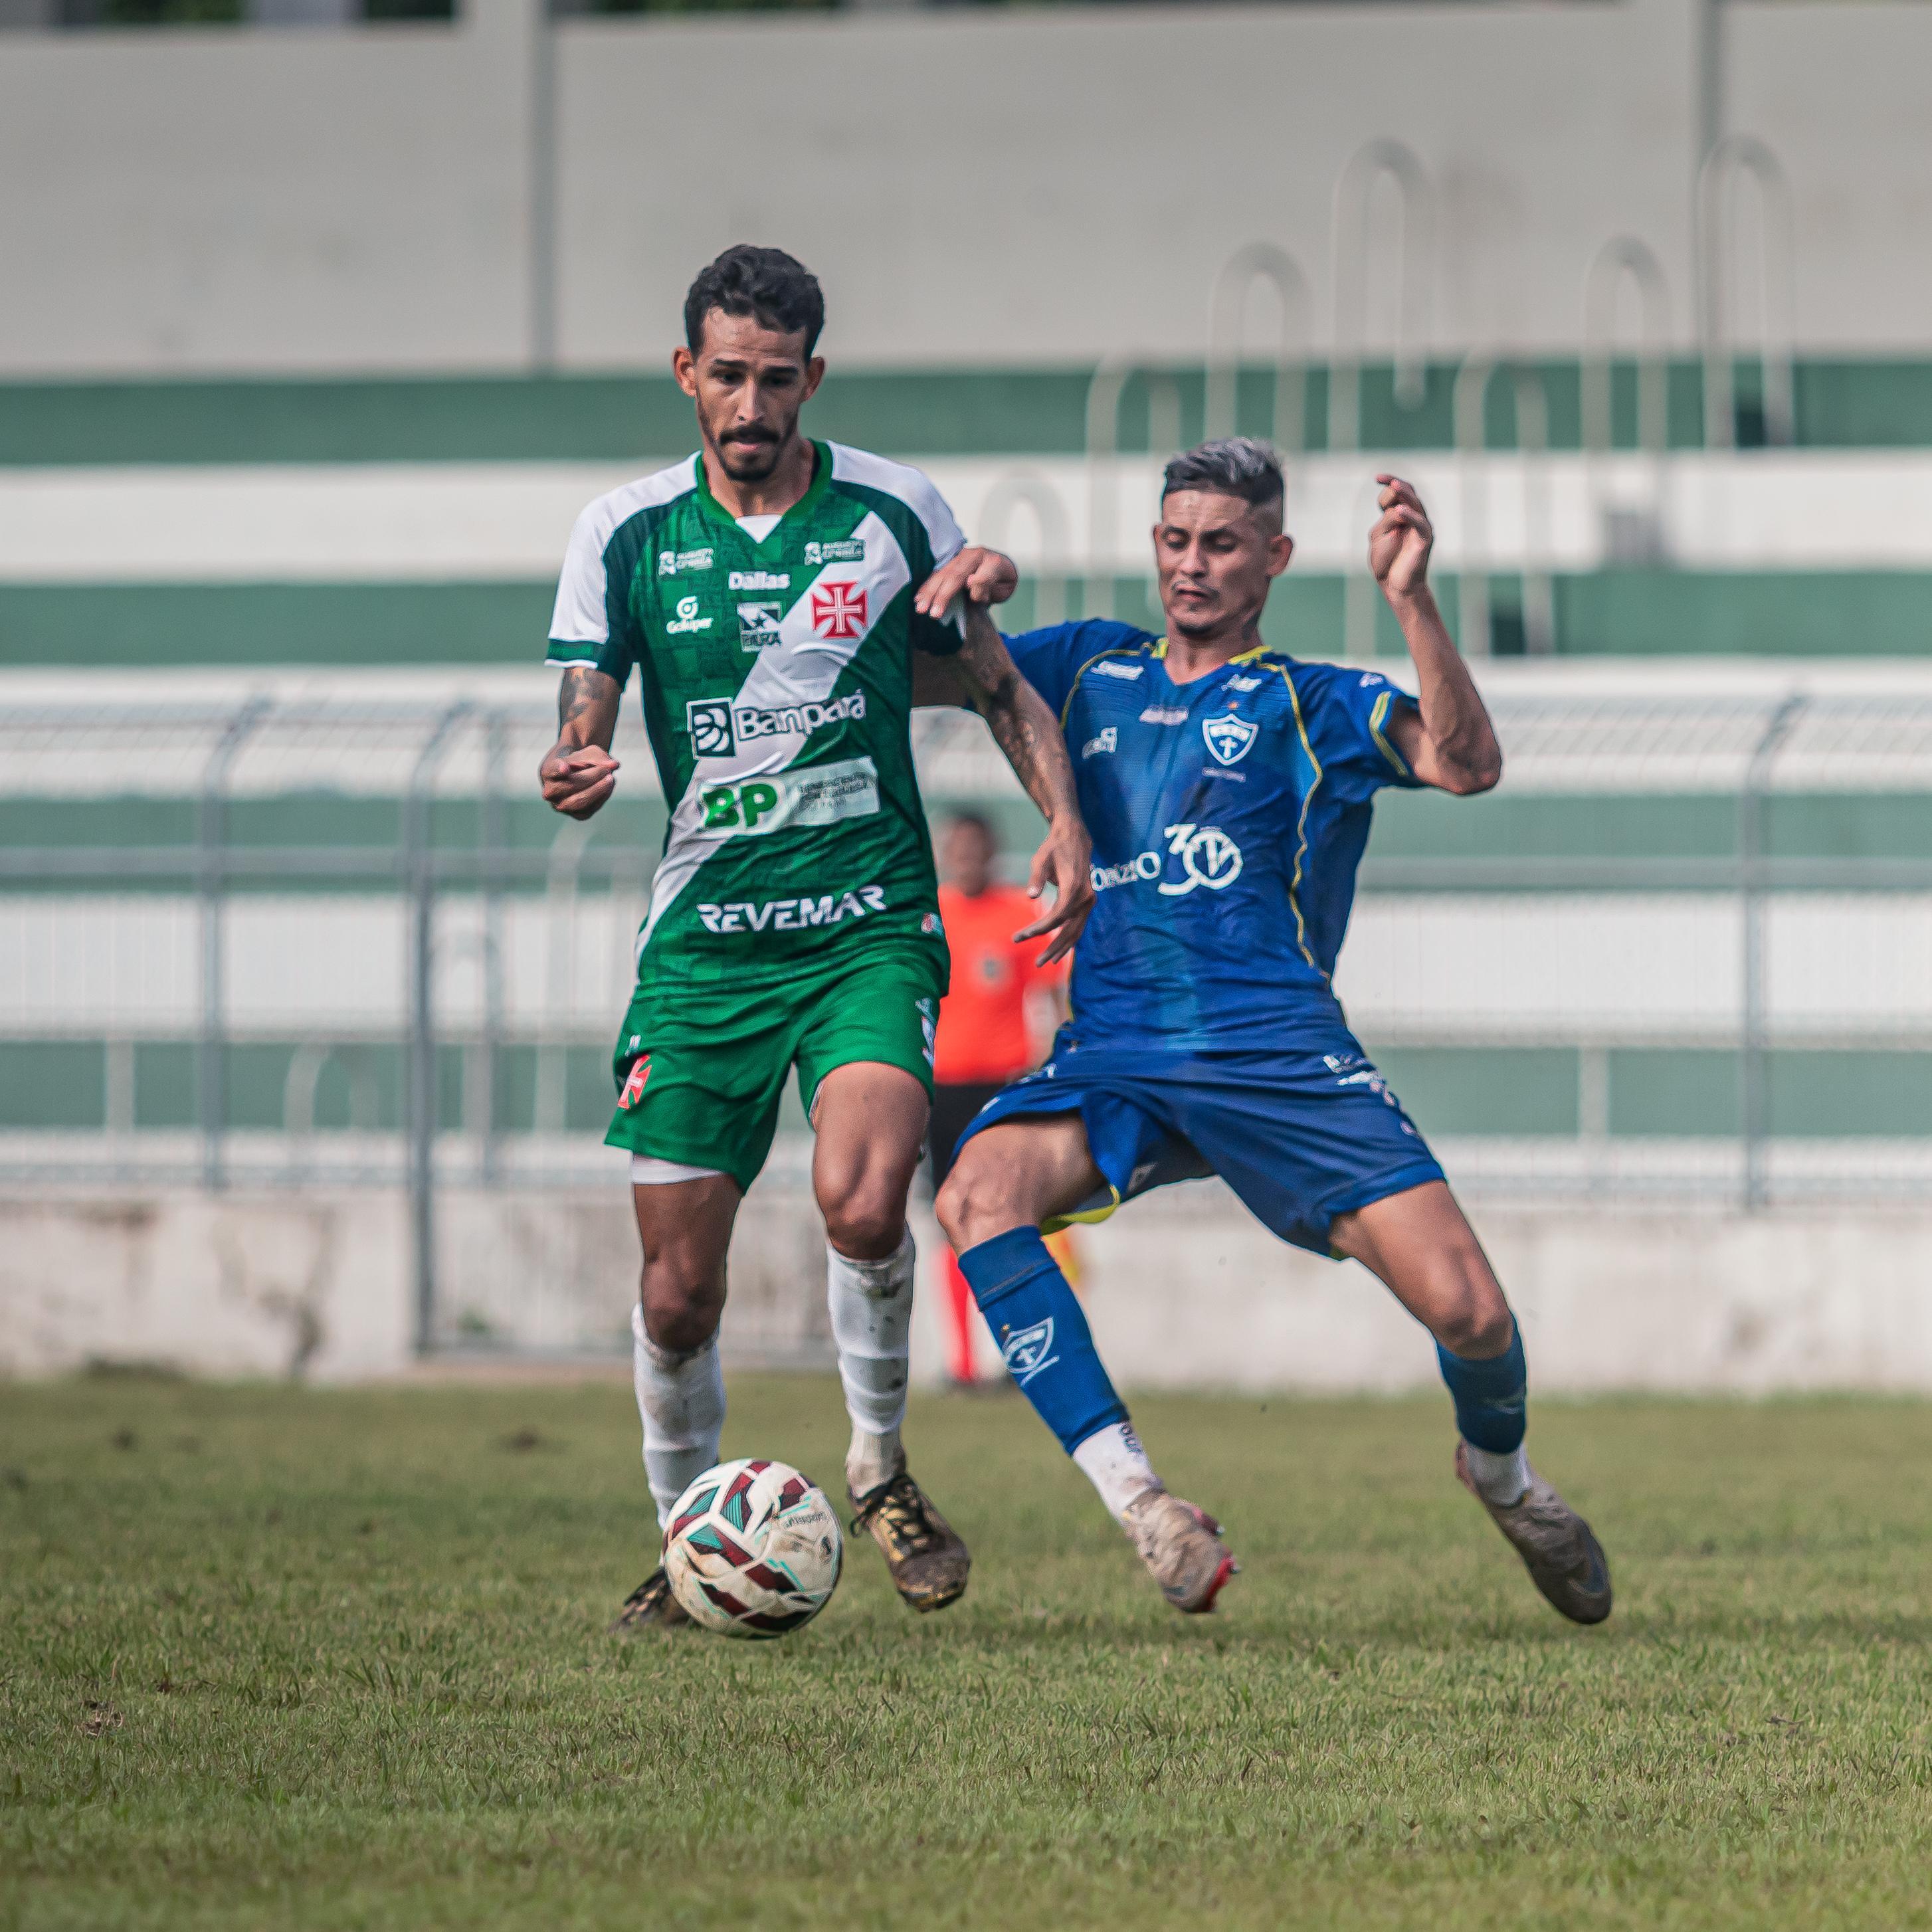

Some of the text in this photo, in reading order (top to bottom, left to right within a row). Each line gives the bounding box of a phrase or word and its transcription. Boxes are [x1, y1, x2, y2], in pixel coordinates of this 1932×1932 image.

[728, 571, 791, 591] Dallas
[702, 783, 778, 828] BP
[696, 884, 887, 933] REVEMAR
